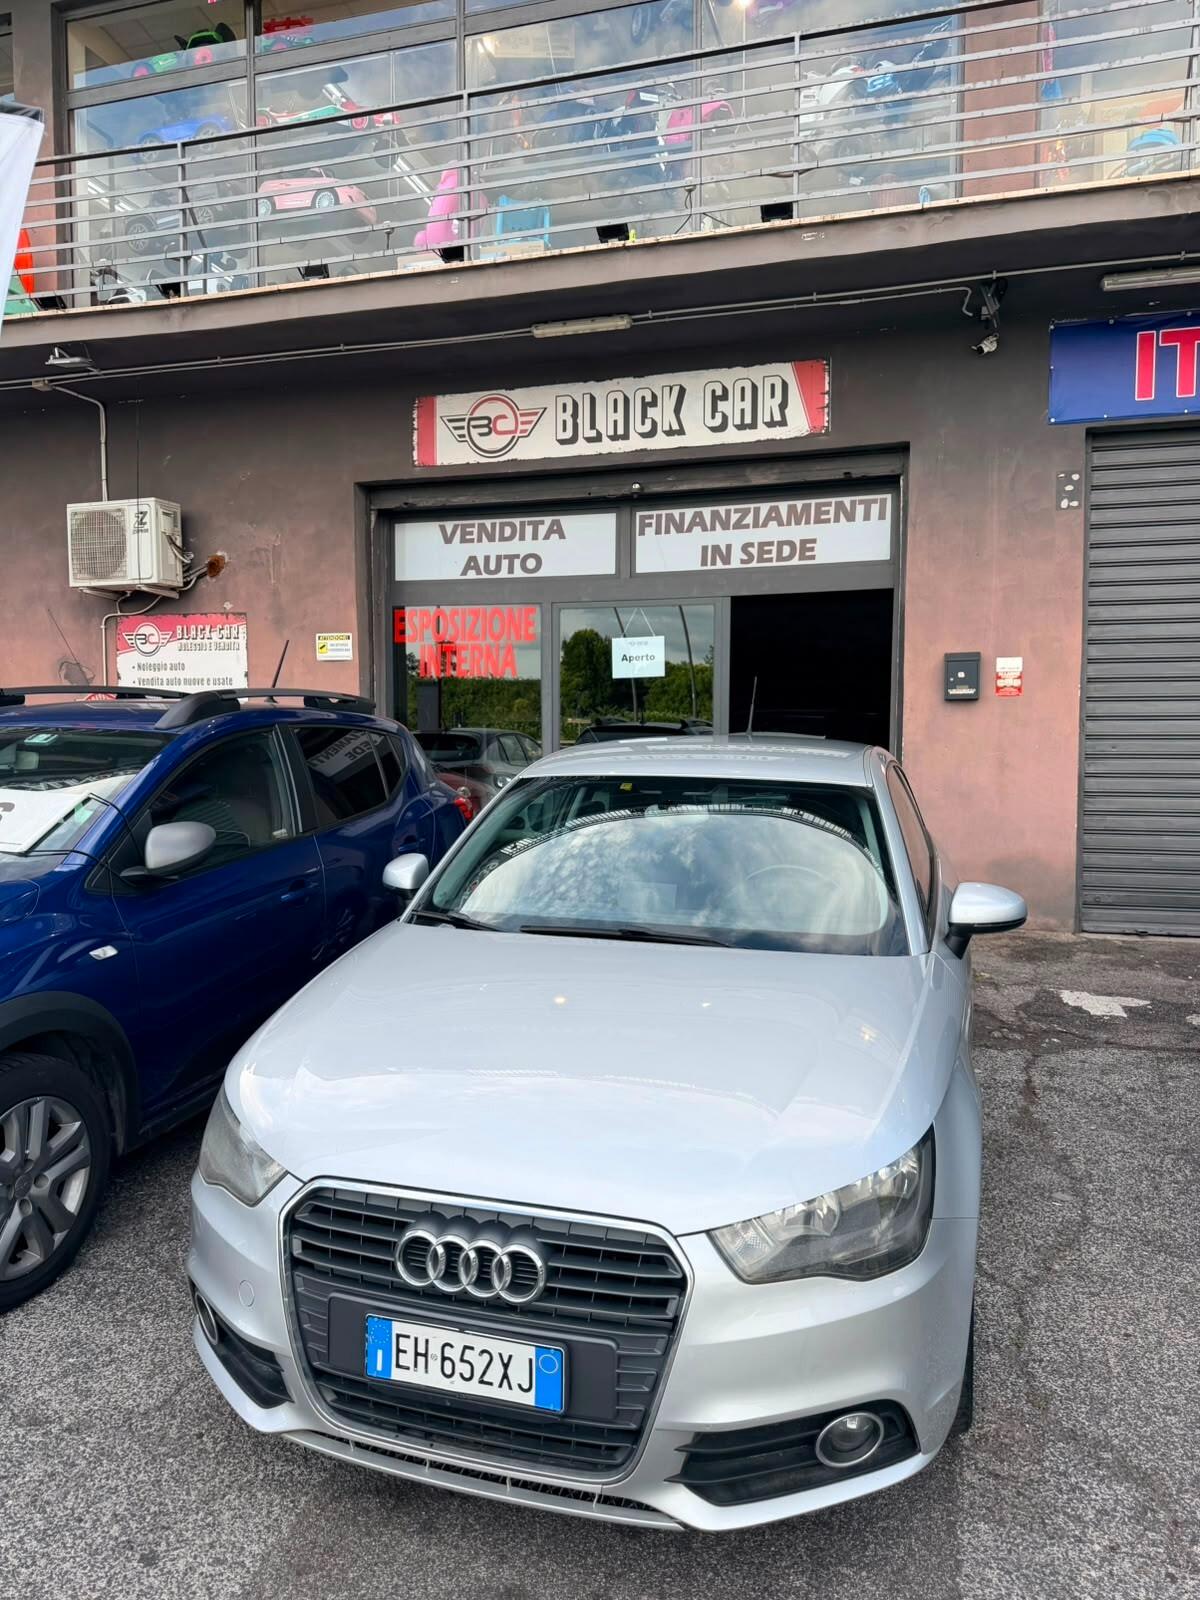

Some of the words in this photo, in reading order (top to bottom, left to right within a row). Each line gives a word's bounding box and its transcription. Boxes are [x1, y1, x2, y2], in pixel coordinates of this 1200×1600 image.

[554, 383, 686, 445] BLACK
[704, 375, 789, 433] CAR
[637, 497, 888, 536] FINANZIAMENTI
[439, 519, 566, 545] VENDITA
[461, 553, 543, 577] AUTO
[700, 544, 732, 568] IN
[739, 538, 817, 565] SEDE
[176, 625, 213, 641] BLACK
[216, 624, 240, 640] CAR
[394, 607, 537, 644] ESPOSIZIONE
[137, 661, 168, 672] Noleggio
[169, 661, 186, 671] auto
[419, 642, 518, 678] INTERNA
[137, 676, 164, 687] Vendita
[165, 676, 182, 687] auto
[183, 678, 205, 687] nuove
[395, 1333, 429, 1375] EH
[440, 1342, 534, 1394] 652XJ
